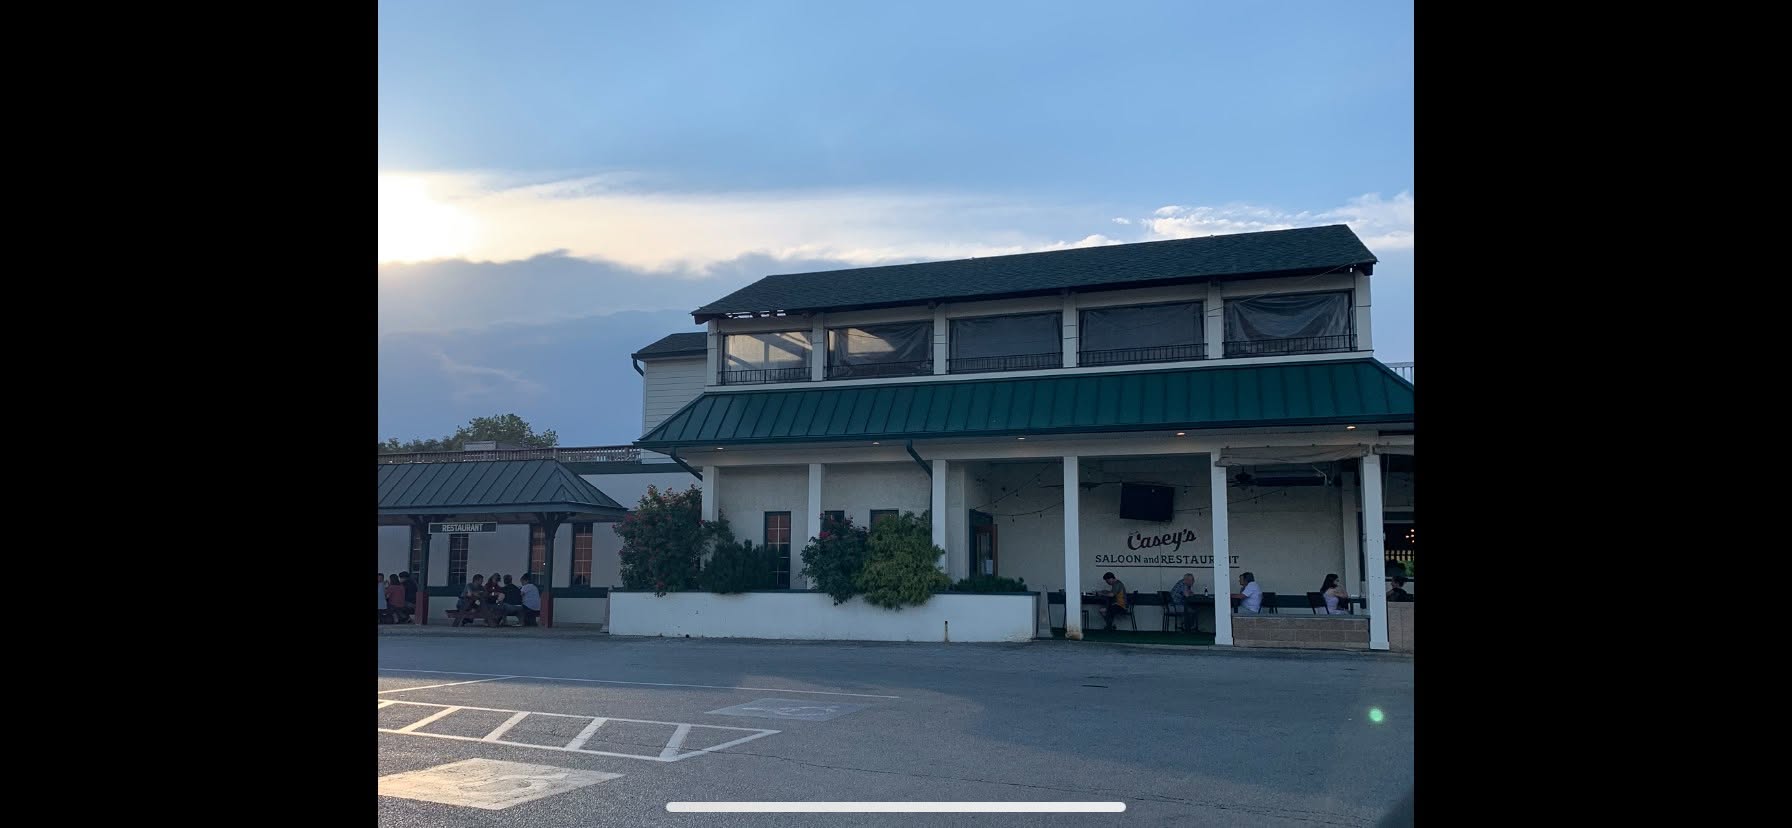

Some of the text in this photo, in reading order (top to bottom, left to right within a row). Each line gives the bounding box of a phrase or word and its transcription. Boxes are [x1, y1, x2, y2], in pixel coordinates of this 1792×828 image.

[442, 524, 484, 532] RESTAURANT
[1127, 529, 1197, 552] Casey's
[1095, 554, 1240, 564] SALOON and RESTAURT
